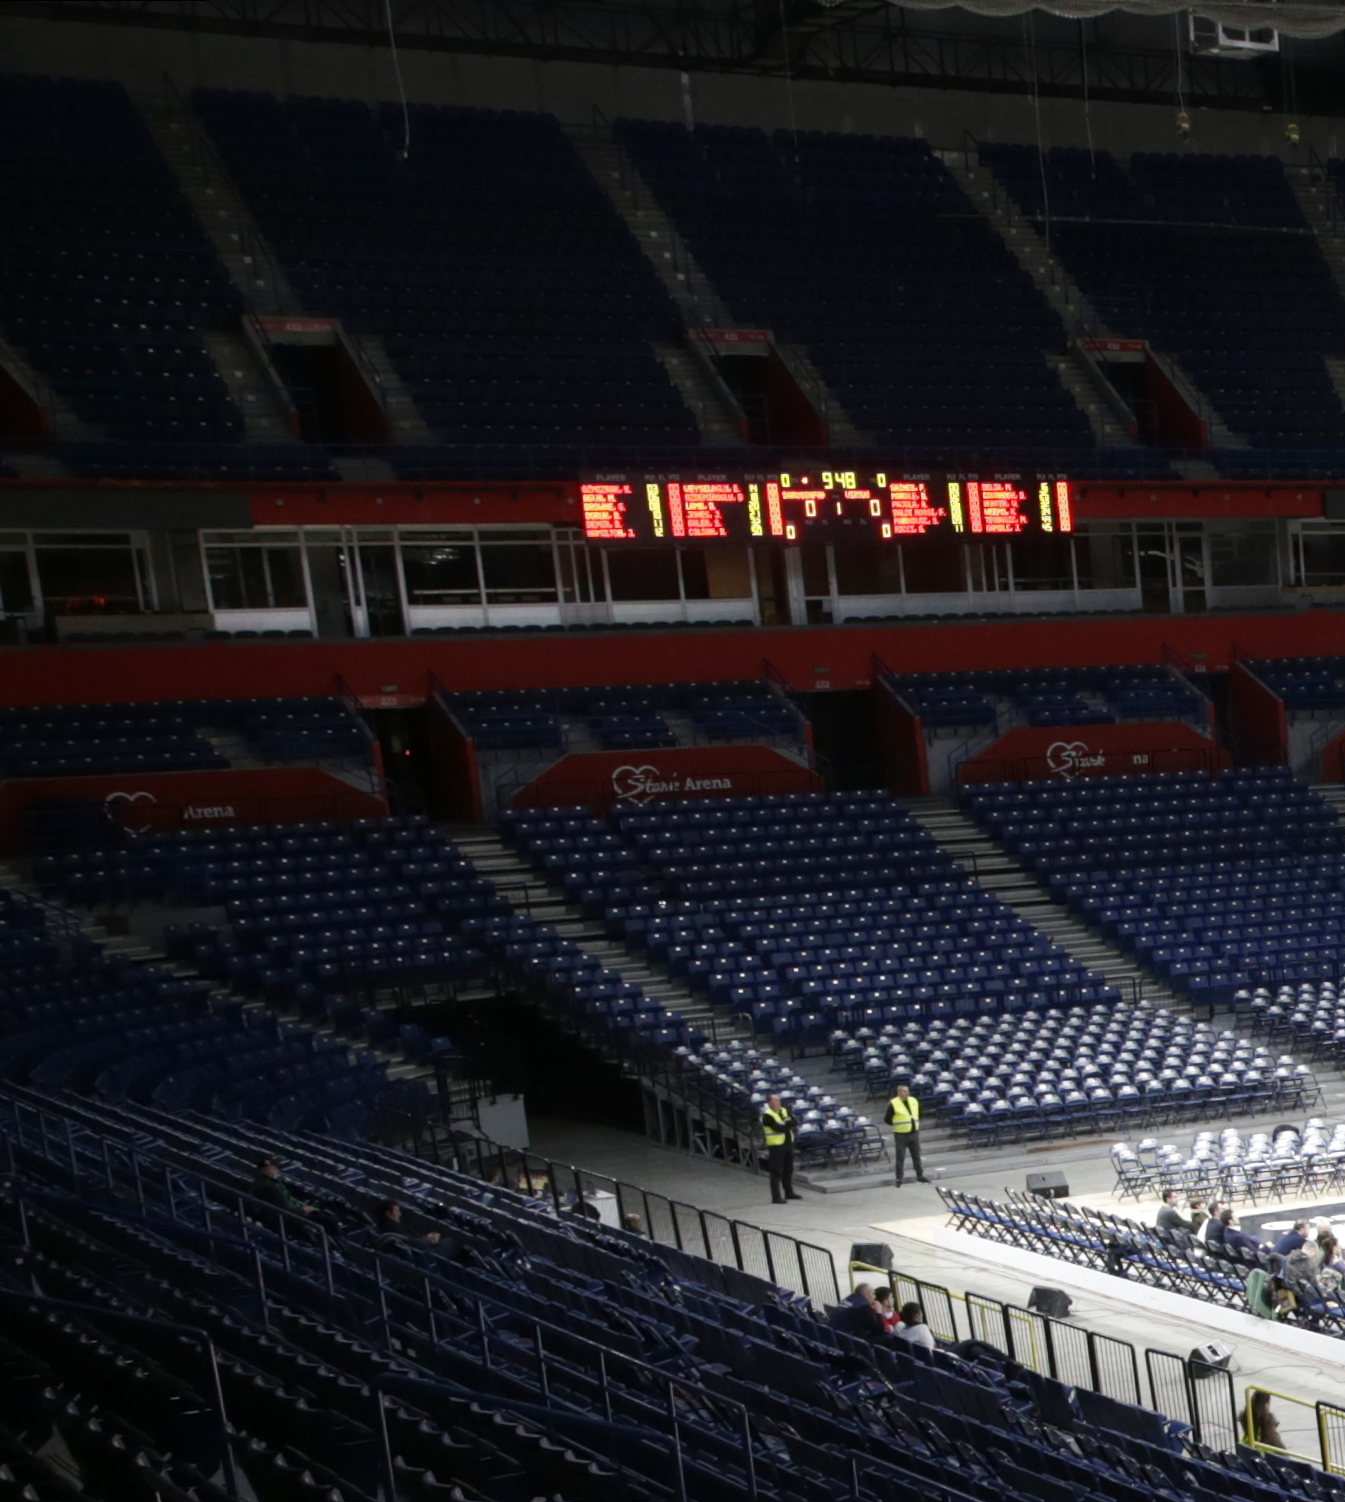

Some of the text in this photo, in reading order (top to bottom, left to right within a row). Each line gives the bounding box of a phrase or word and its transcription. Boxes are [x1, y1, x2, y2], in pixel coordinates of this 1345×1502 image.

[805, 500, 816, 517] 0
[869, 499, 881, 516] 0
[684, 776, 732, 791] Arena
